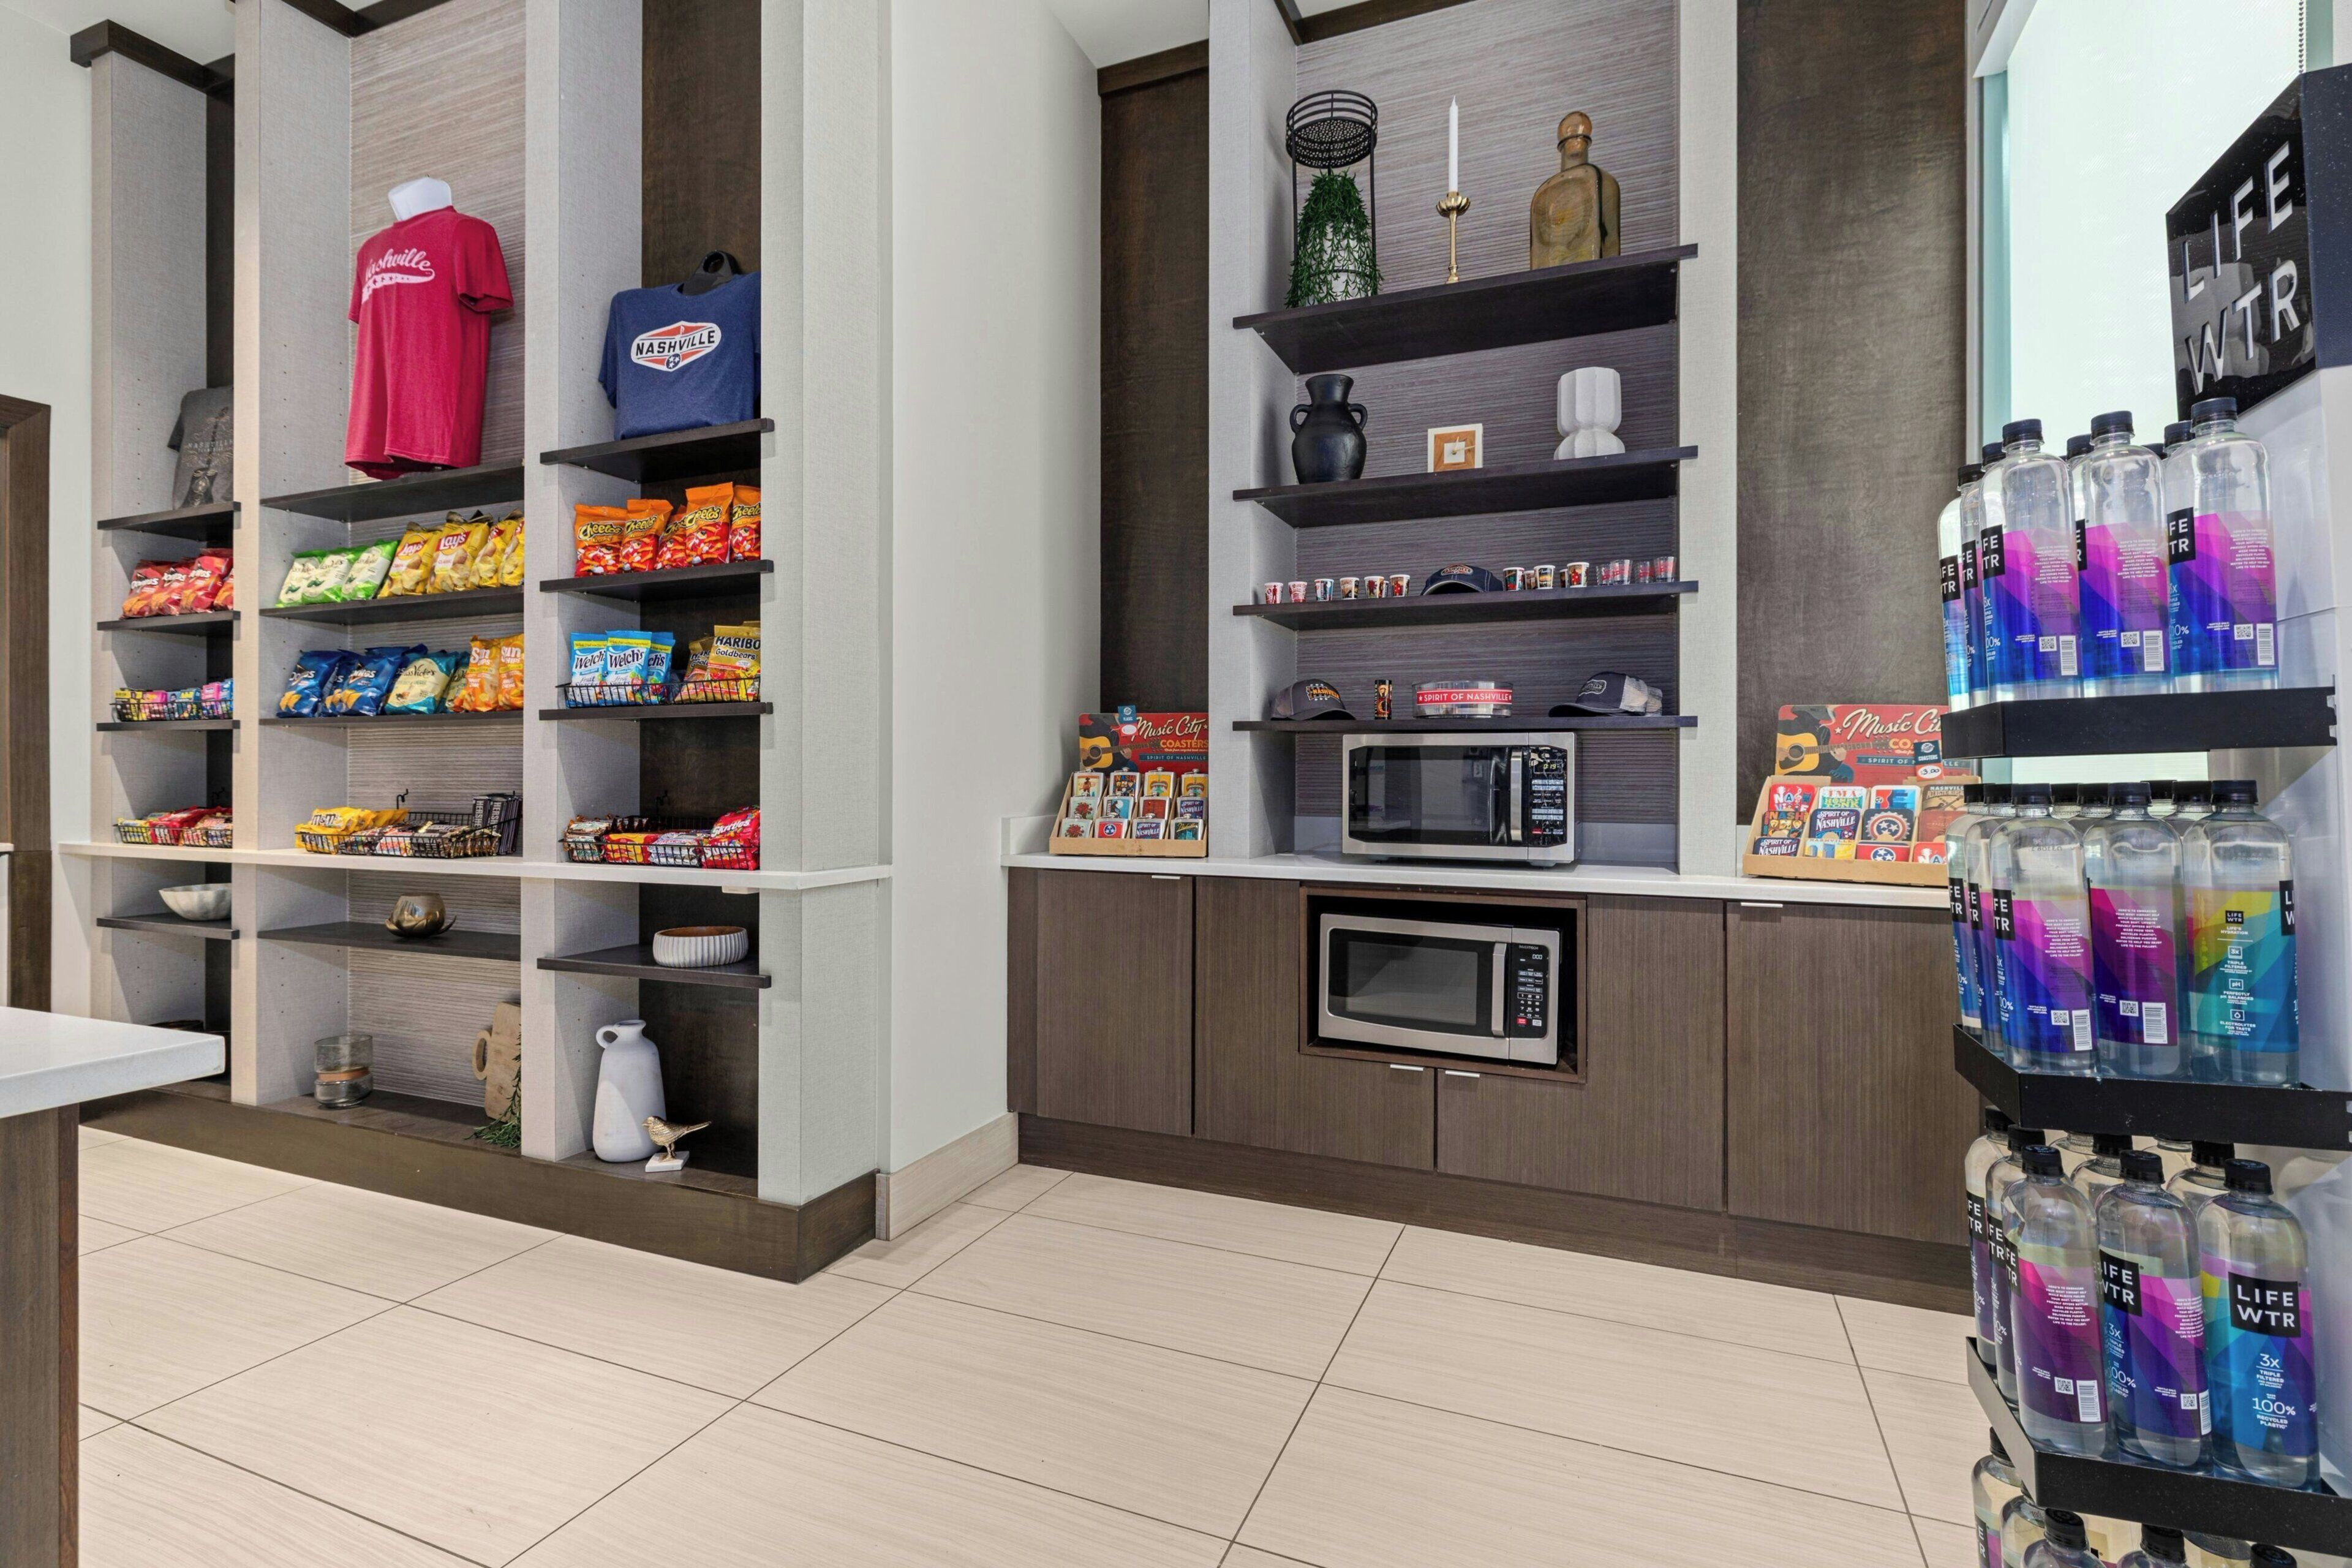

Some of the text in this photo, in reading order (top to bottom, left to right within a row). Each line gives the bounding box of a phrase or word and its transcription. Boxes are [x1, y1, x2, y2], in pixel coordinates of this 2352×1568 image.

[2182, 140, 2293, 304] LIFE
[2184, 258, 2301, 394] WTR
[635, 329, 715, 357] NASHVILLE
[578, 522, 621, 540] Cheetos
[2169, 518, 2188, 536] FE
[398, 540, 424, 556] Lay's
[439, 533, 466, 549] Lay's
[1983, 535, 1999, 551] FE
[2169, 538, 2189, 554] TR
[1983, 554, 1999, 570] TR
[1942, 564, 1955, 578] FE
[1942, 581, 1956, 594] TR
[715, 637, 761, 650] HARIBO
[609, 649, 644, 668] Welch's
[647, 654, 665, 666] ch's
[715, 649, 756, 660] Goldbears
[1424, 693, 1509, 702] SPIRIT OF NASHVILLE
[1131, 715, 1206, 742] Music City
[1842, 709, 1913, 741] Music
[1160, 739, 1208, 748] COASTERS
[474, 801, 484, 829] HERSHE
[1181, 806, 1203, 815] NASHVILLE
[1769, 812, 1804, 820] NASH
[710, 820, 751, 837] Skittles
[1816, 816, 1855, 831] NASHVILLE
[1137, 828, 1159, 838] NASHVILLE
[1759, 844, 1797, 855] NASHVILLE
[1950, 902, 1962, 914] TR
[1993, 899, 2008, 913] FE
[1994, 916, 2010, 931] TR
[1967, 1200, 1981, 1217] FE
[1969, 1216, 1983, 1234] TR
[1989, 1223, 2003, 1242] FE
[1989, 1240, 2004, 1260] TR
[2006, 1247, 2016, 1267] FE
[2007, 1265, 2018, 1286] TR
[2103, 1262, 2133, 1285] IFE
[2237, 1284, 2294, 1307] LIFE
[2237, 1304, 2295, 1328] WTR
[2260, 1354, 2280, 1368] 3x
[2111, 1366, 2136, 1388] 00%
[2256, 1374, 2284, 1383] FILTERED
[2252, 1398, 2296, 1415] 100%
[2256, 1414, 2288, 1424] RECYCLED
